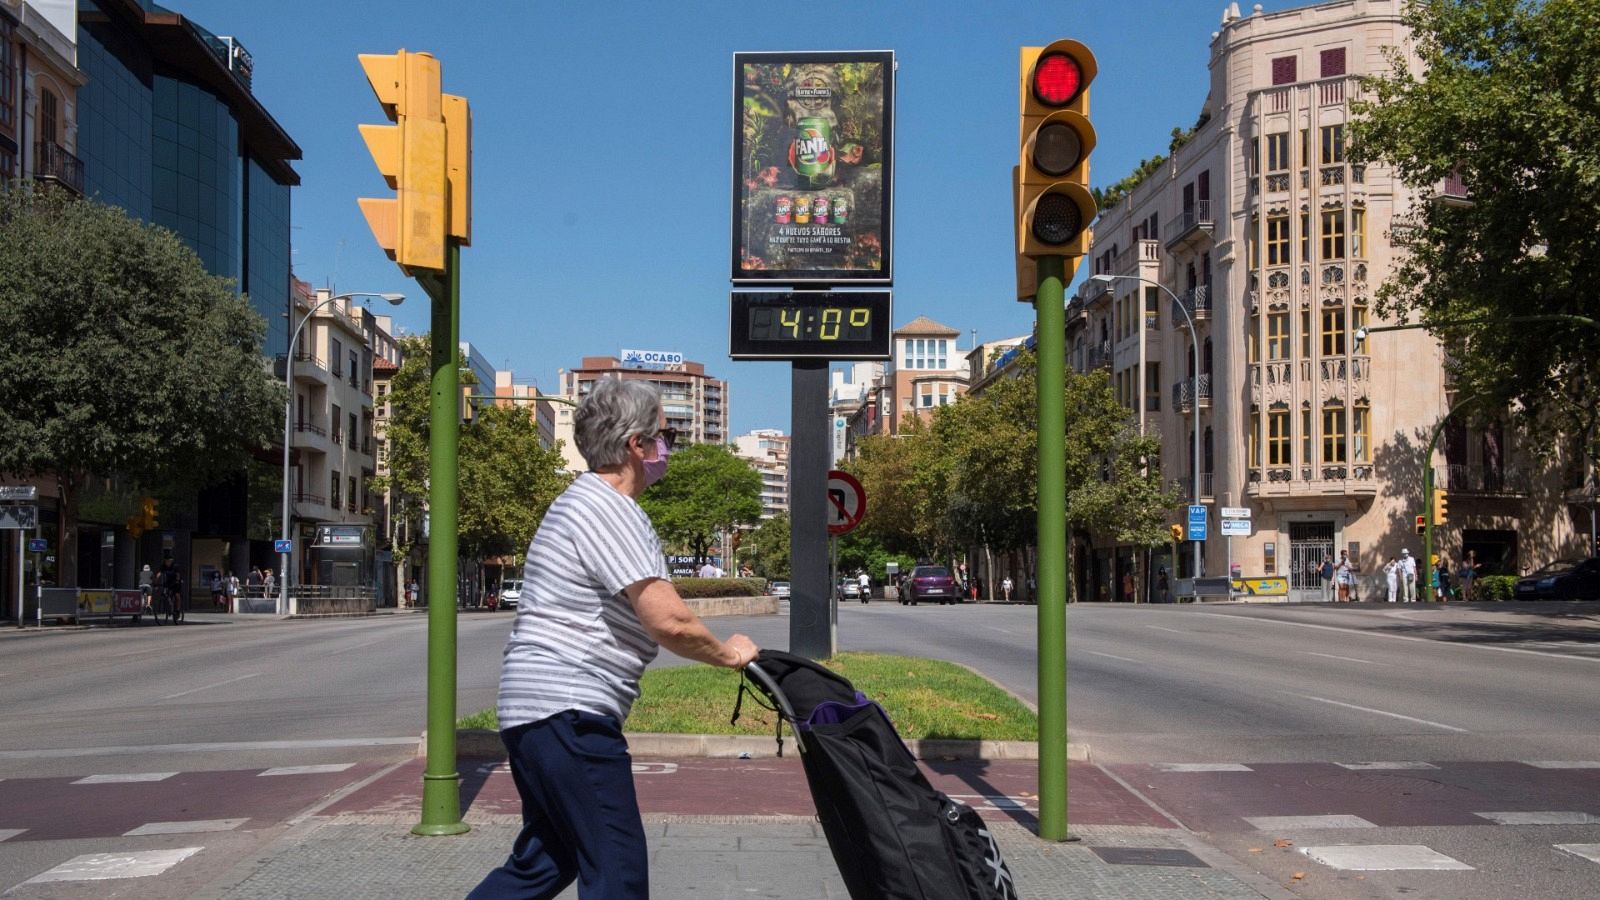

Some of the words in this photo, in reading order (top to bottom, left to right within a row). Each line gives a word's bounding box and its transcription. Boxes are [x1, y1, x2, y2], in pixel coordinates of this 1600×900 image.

[796, 137, 828, 155] FANTA
[779, 227, 784, 236] 4
[785, 227, 810, 236] NUEVOS
[812, 227, 841, 236] SABORES
[644, 353, 681, 363] OCASO
